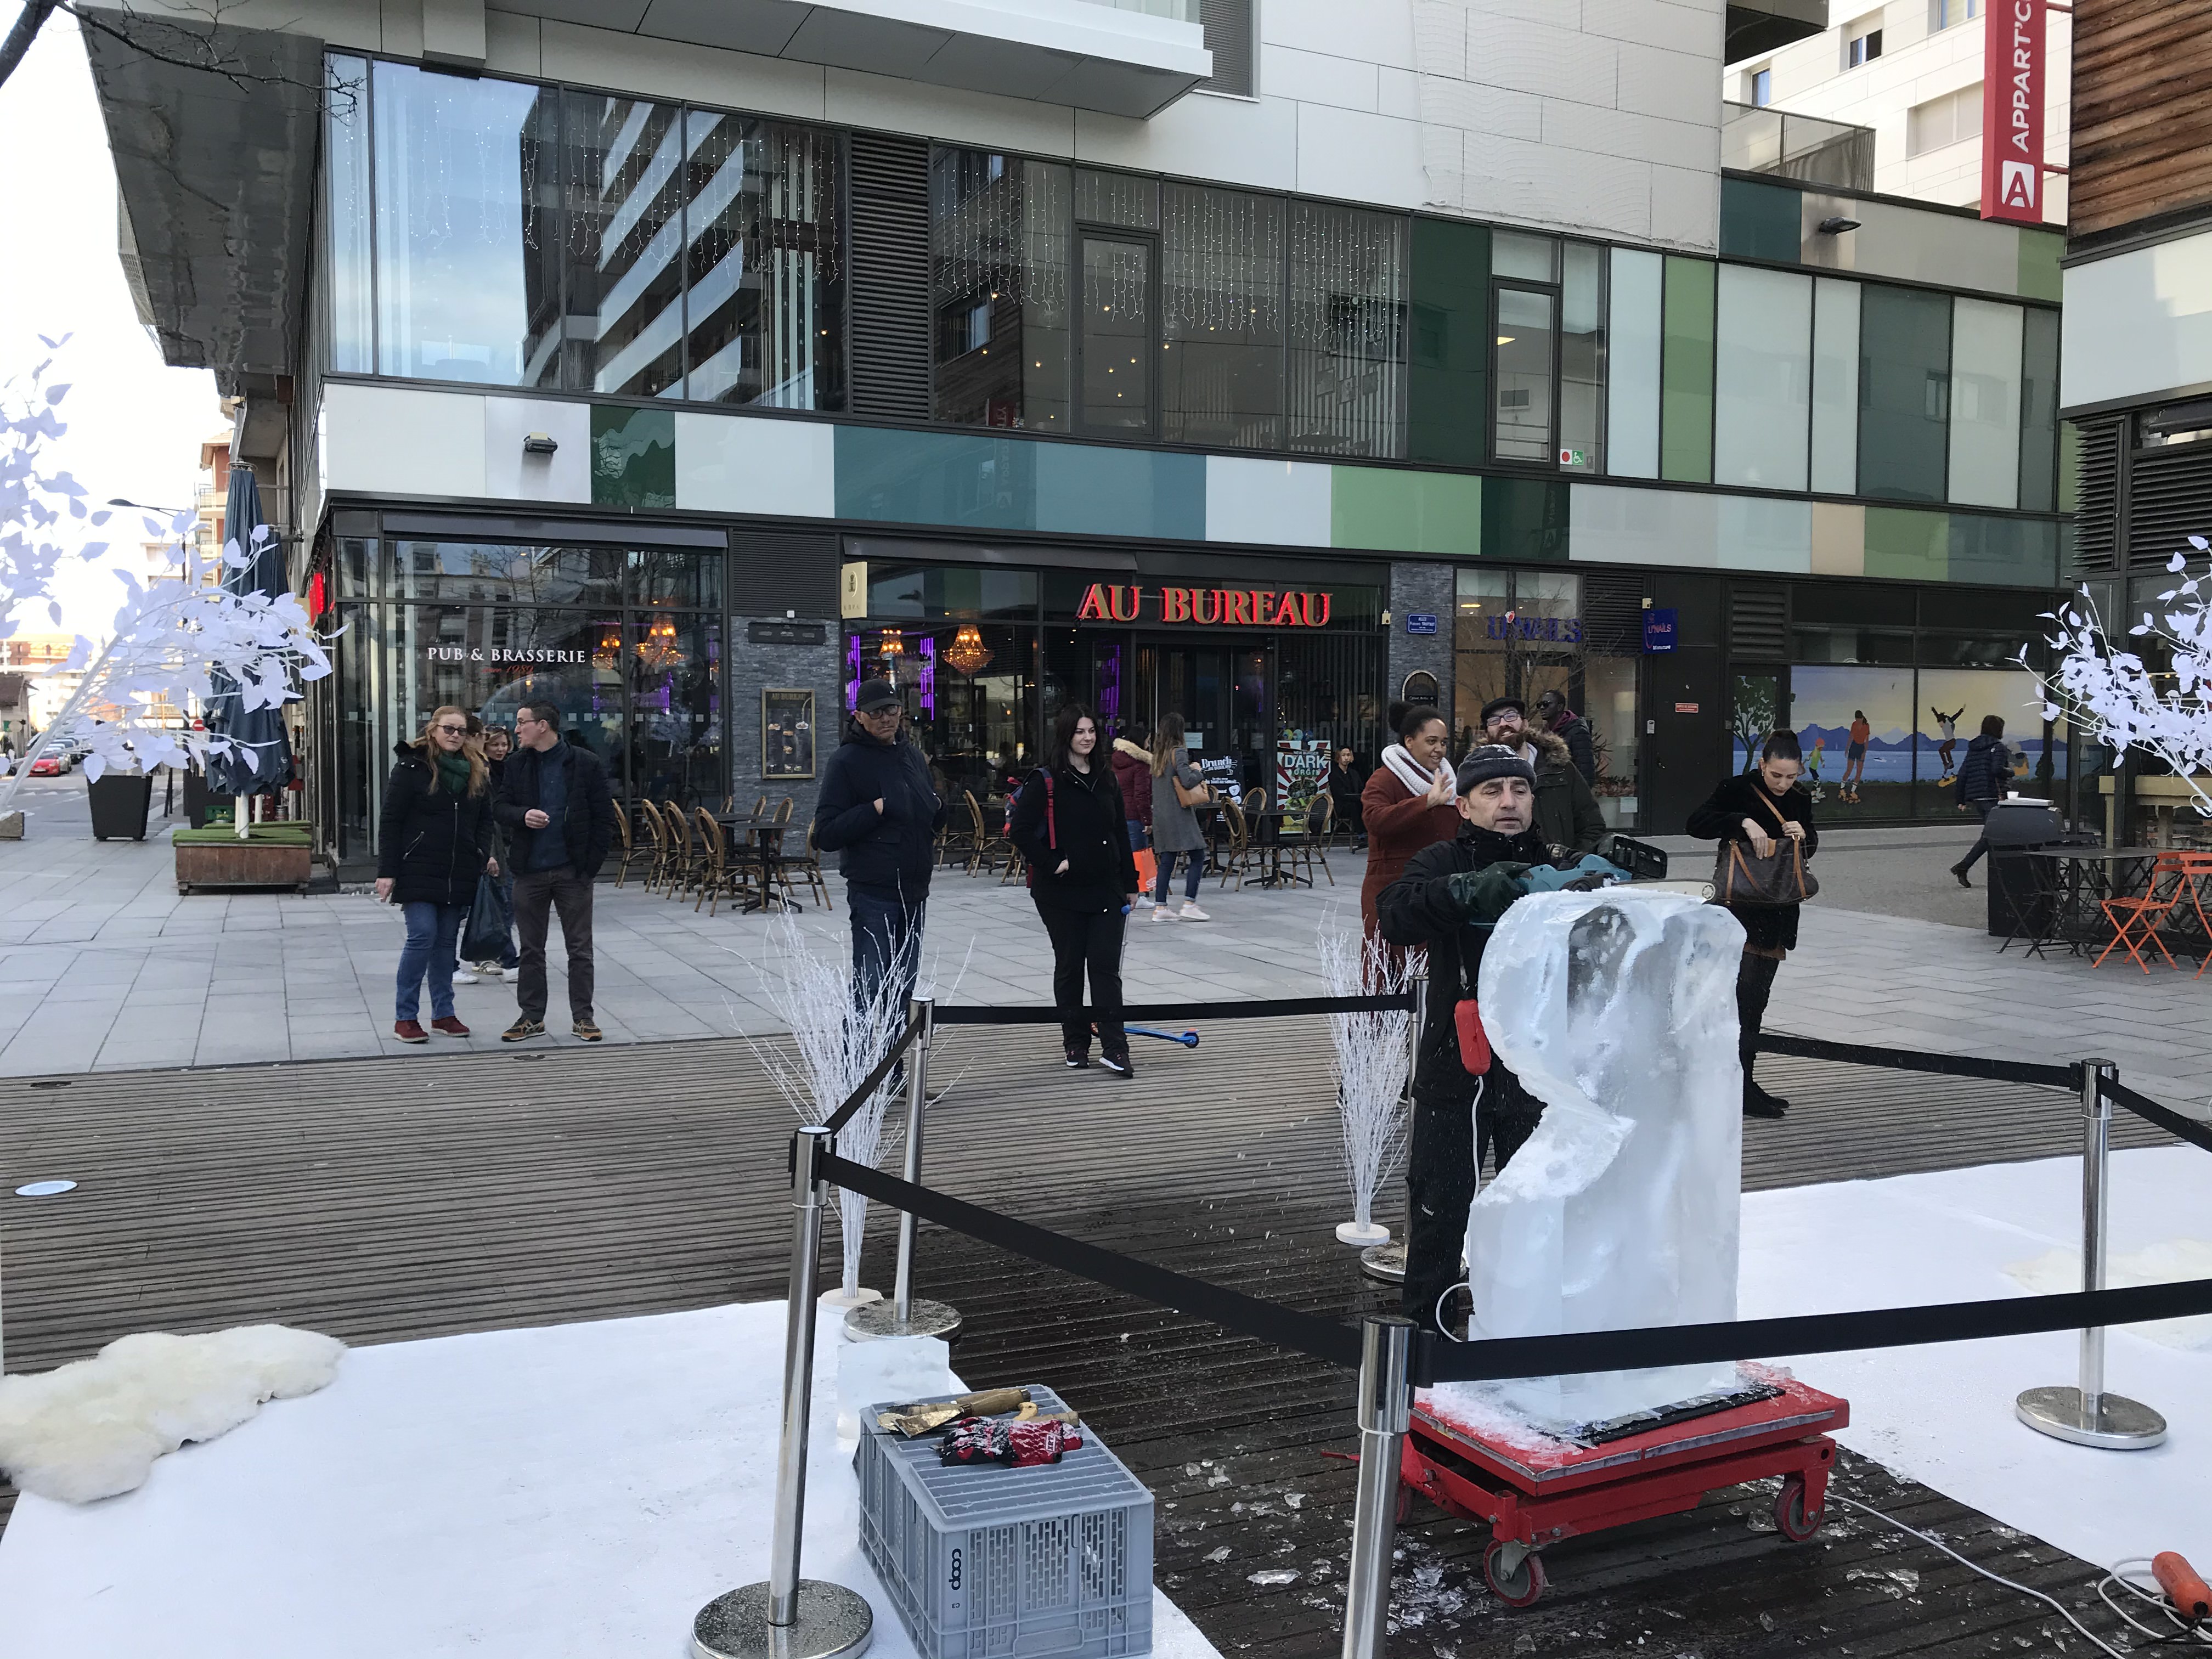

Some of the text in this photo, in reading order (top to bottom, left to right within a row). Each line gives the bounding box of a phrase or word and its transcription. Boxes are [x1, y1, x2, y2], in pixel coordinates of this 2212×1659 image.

[2012, 0, 2032, 154] APPART'C
[1079, 583, 1333, 627] AU BUREAU
[427, 647, 586, 663] PUB & BRASSERIE
[1201, 755, 1232, 769] Brunch
[1284, 754, 1327, 769] DARK
[948, 1548, 961, 1590] coop
